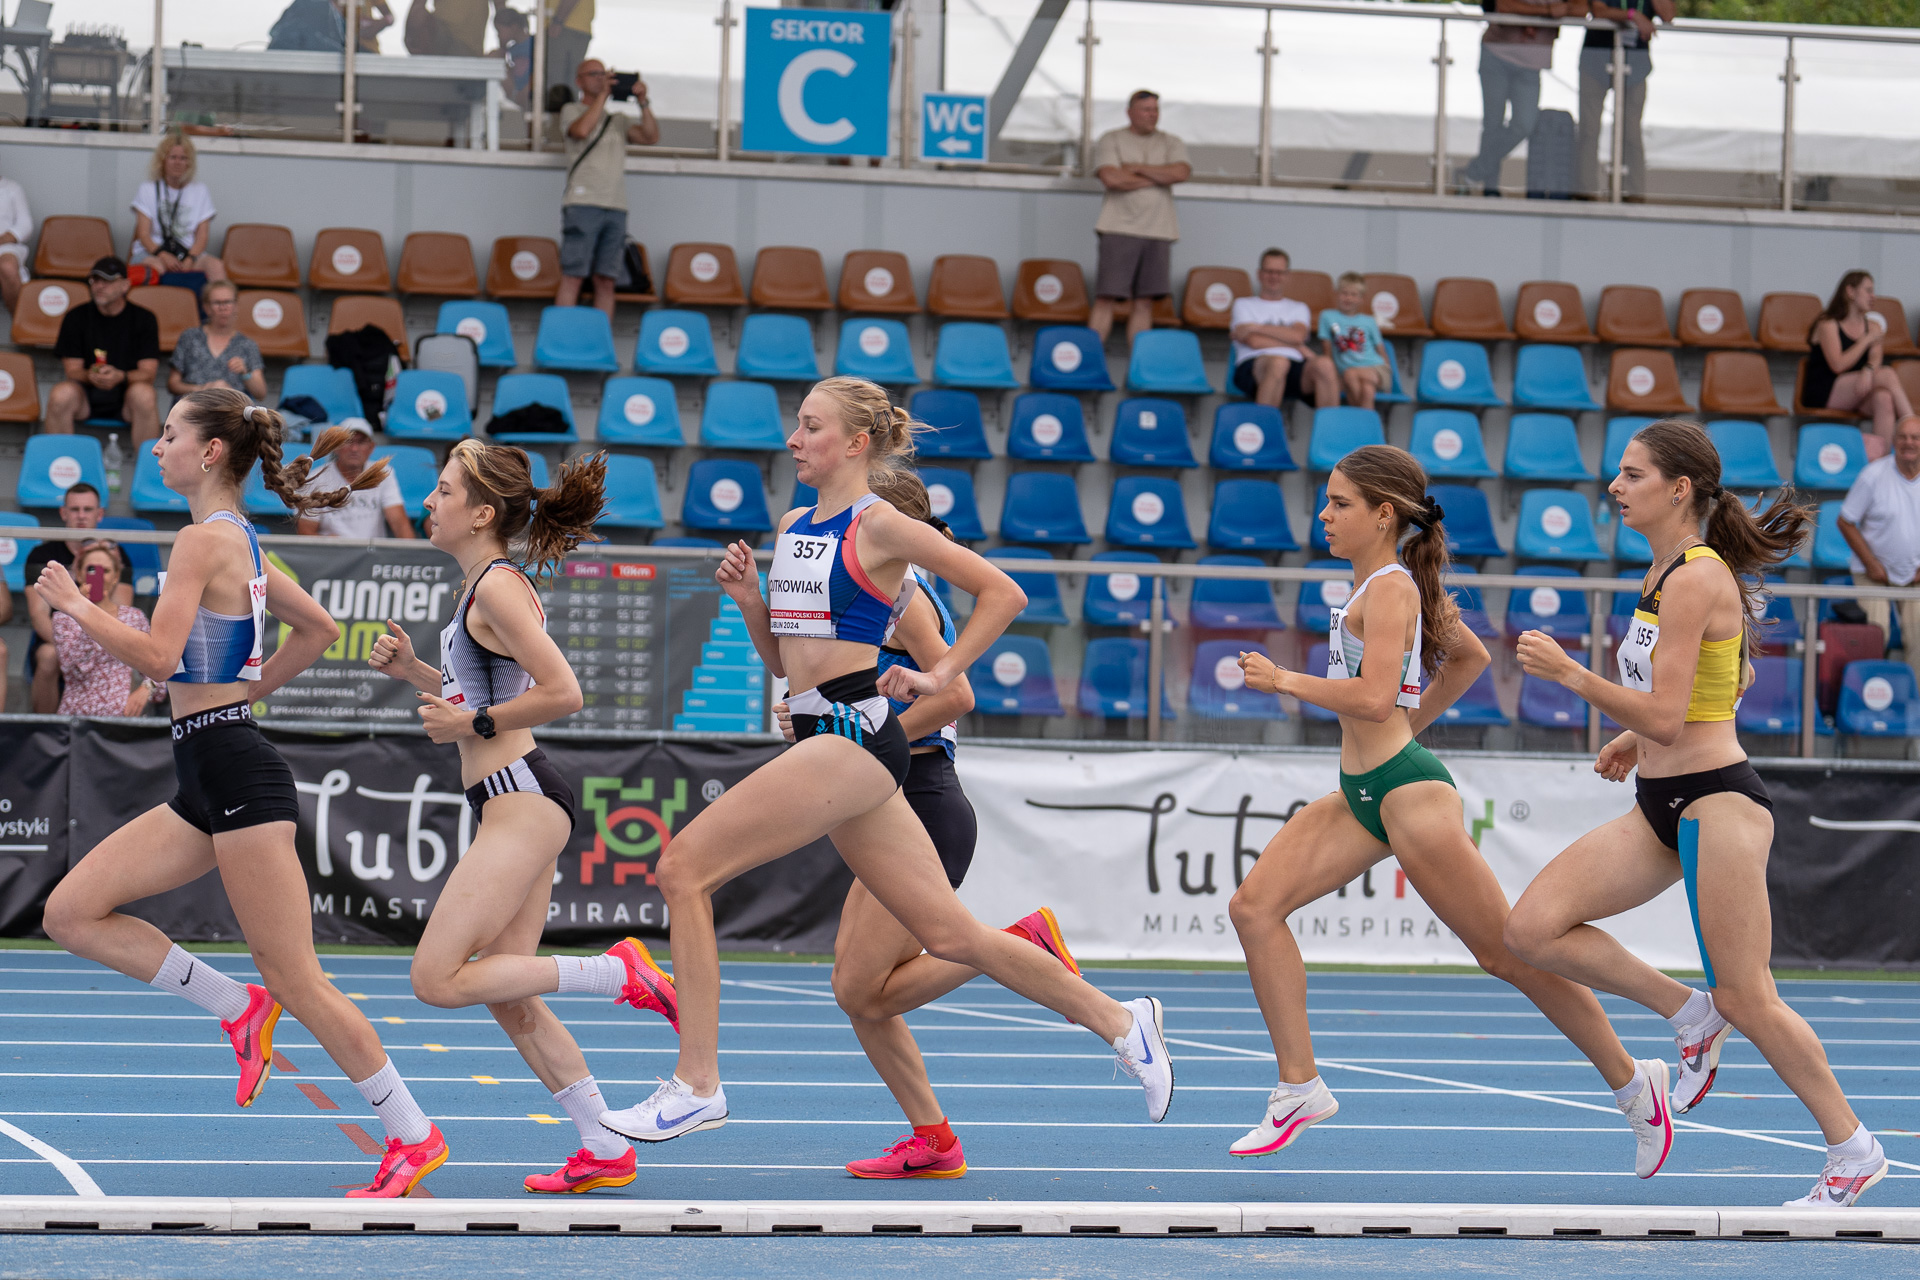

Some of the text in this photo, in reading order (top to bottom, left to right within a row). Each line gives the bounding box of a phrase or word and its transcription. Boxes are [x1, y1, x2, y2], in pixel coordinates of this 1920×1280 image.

[770, 18, 864, 44] SEKTOR
[777, 48, 857, 145] C
[926, 100, 983, 134] WC
[793, 540, 828, 560] 357
[372, 564, 444, 580] PERFECT
[311, 579, 450, 622] runner
[784, 621, 799, 630] 2024
[793, 611, 812, 619] POLSKI
[1636, 626, 1654, 647] 155
[186, 707, 241, 734] NIKE
[313, 893, 428, 920] MIAST
[1144, 915, 1226, 935] MIAS
